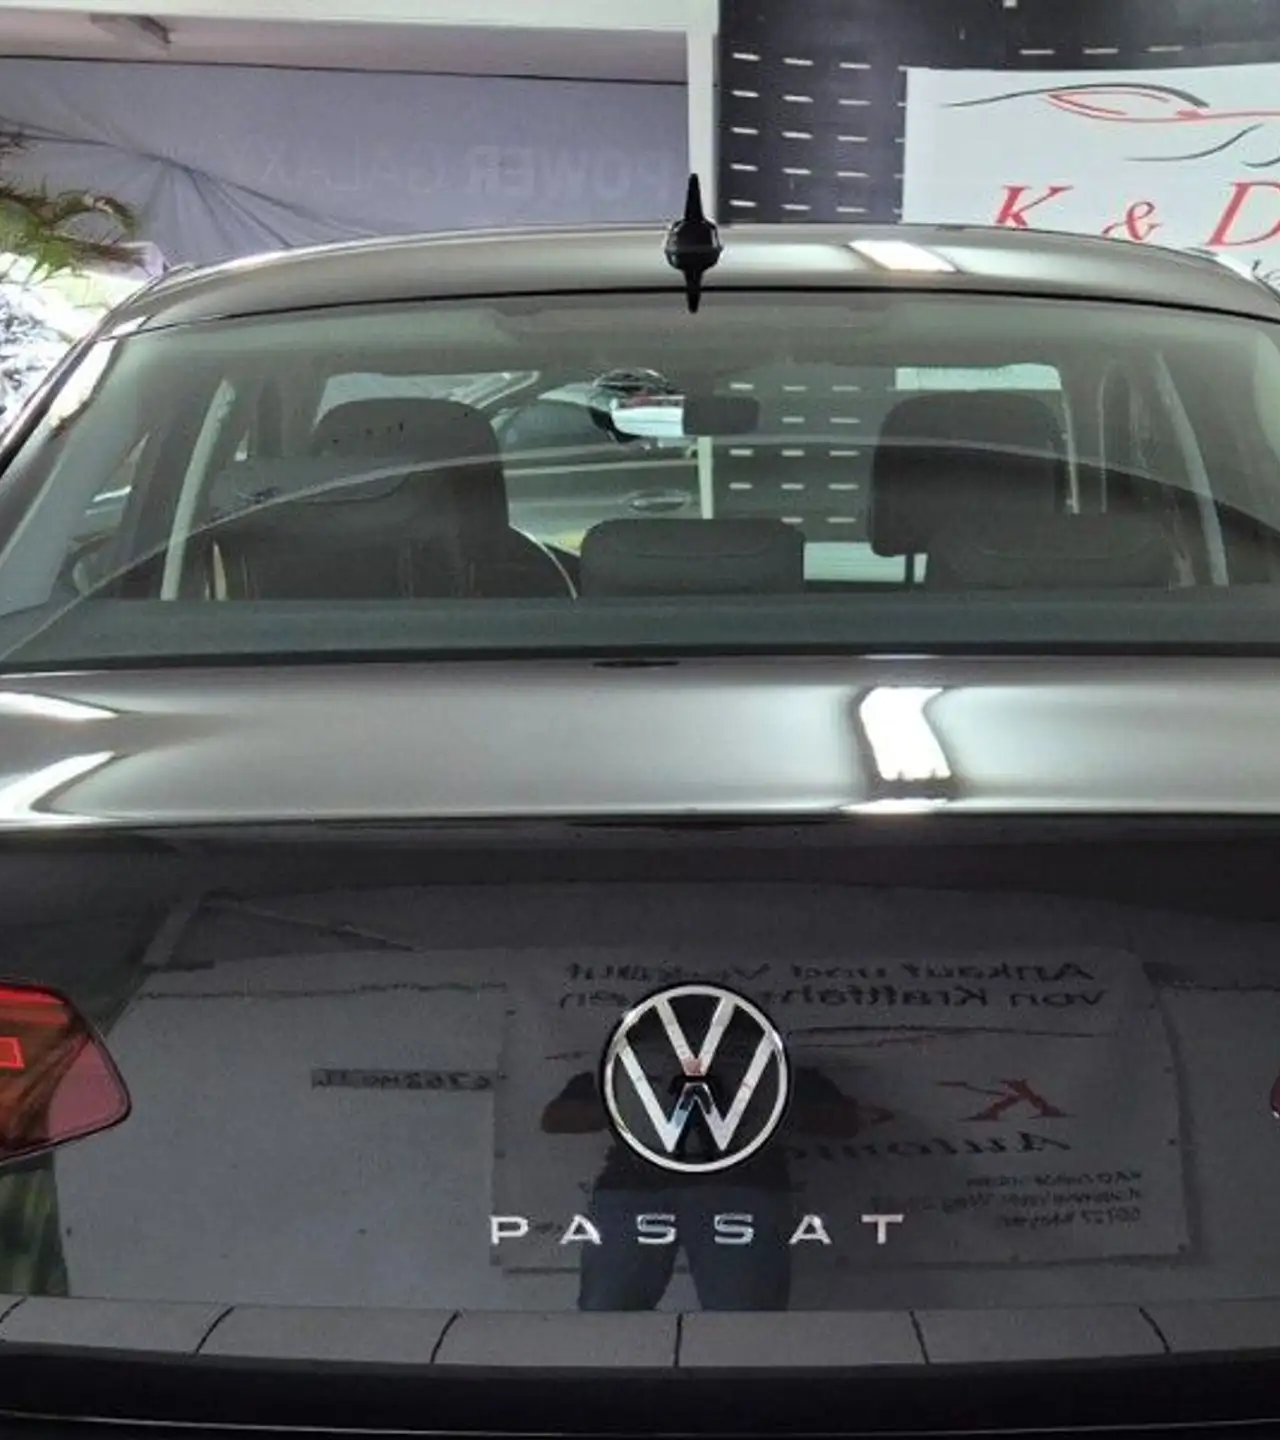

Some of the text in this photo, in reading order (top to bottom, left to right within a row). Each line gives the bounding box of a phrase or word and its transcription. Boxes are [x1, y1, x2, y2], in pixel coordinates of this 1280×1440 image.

[995, 184, 1073, 227] K
[1101, 201, 1162, 242] &
[489, 1213, 906, 1246] PASSAT
